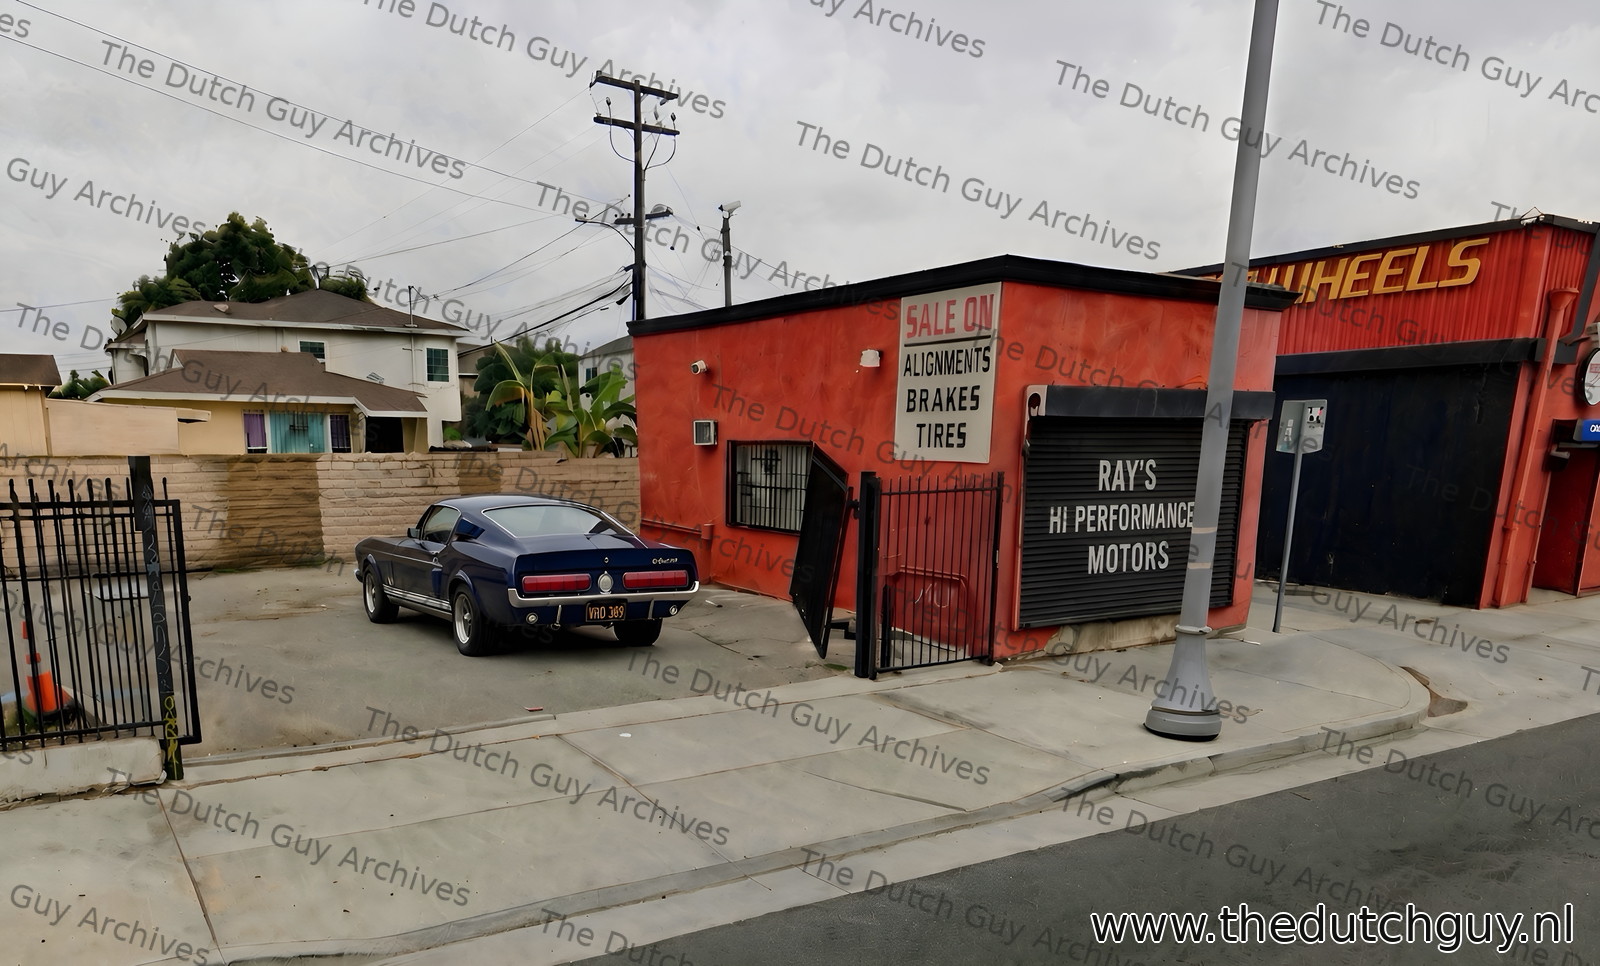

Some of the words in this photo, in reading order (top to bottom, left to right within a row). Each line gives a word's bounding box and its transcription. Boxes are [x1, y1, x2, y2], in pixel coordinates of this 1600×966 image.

[906, 299, 956, 338] SALE
[963, 294, 994, 332] ON
[903, 346, 991, 377] ALIGNMENTS
[906, 385, 980, 413] BRAKES
[916, 422, 967, 448] TIRES
[1049, 506, 1068, 534] HI
[1074, 501, 1196, 533] PERFORMANCE
[1087, 540, 1169, 575] MOTORS
